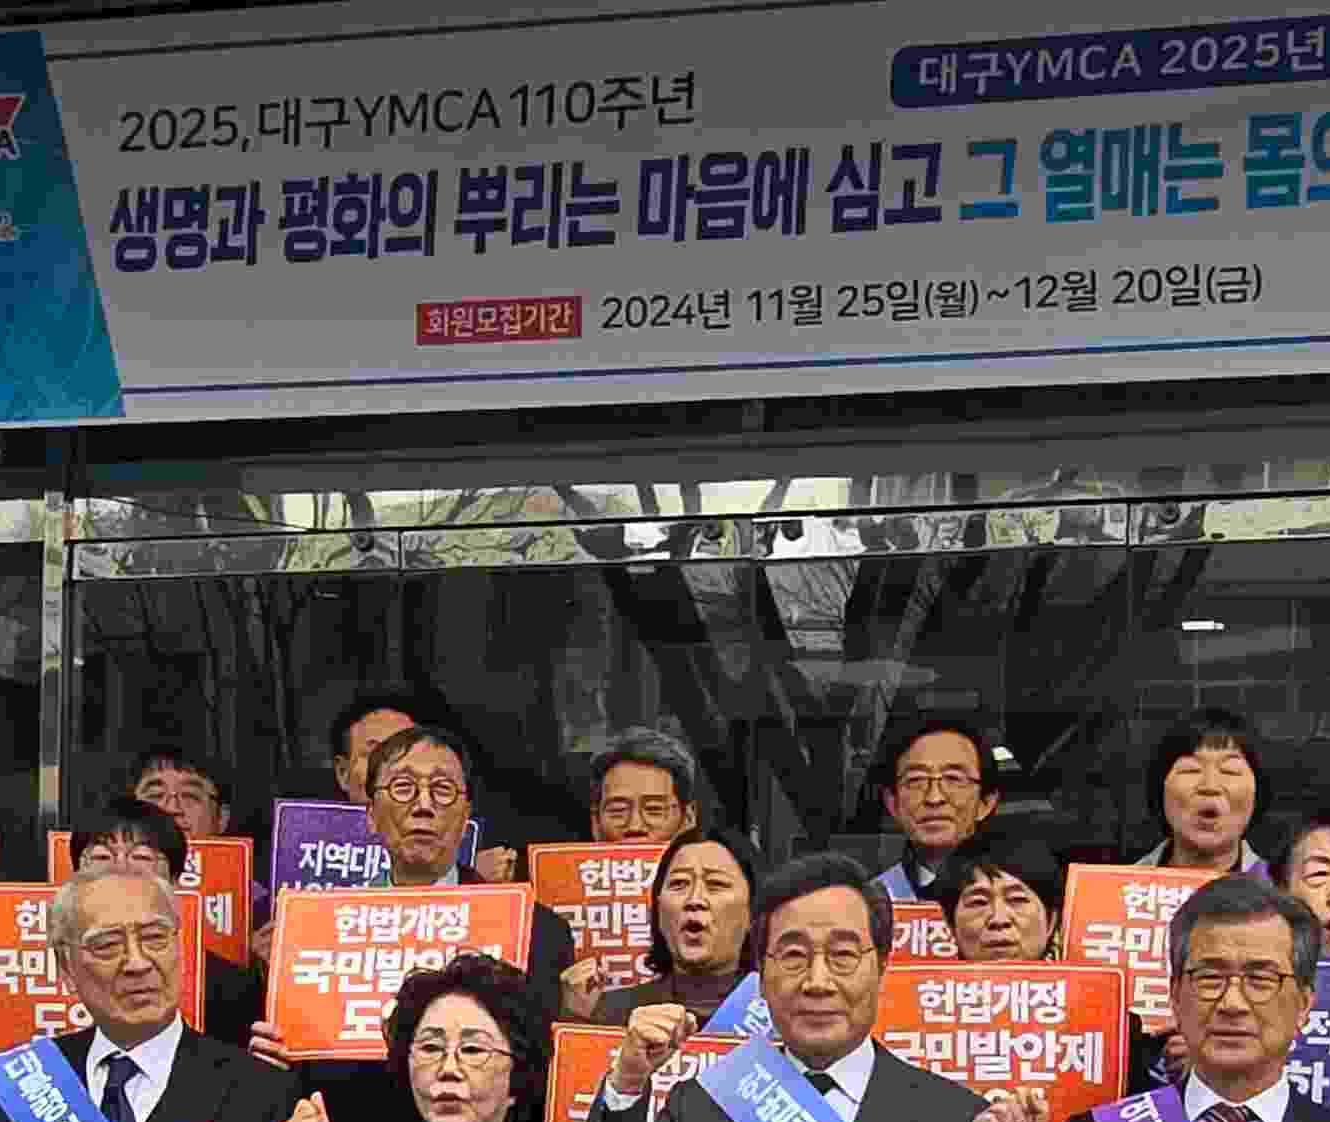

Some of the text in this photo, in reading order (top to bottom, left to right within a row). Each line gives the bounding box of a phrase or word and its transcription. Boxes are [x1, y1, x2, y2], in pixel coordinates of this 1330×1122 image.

[918, 46, 1143, 96] 대구YMCA
[1159, 24, 1327, 78] 2025년
[109, 181, 266, 273] 생명과
[278, 168, 440, 265] 평화의
[453, 158, 622, 256] 뿌리는
[637, 146, 812, 244] 마음에
[825, 139, 943, 234] 심고
[958, 139, 1019, 220] 그
[1038, 119, 1224, 226] 열매는
[599, 289, 733, 333] 2024년
[746, 283, 824, 328] 11월
[1111, 263, 1265, 310] 20일(금)
[424, 302, 575, 341] 회원모집기간
[298, 841, 390, 879] 지역대
[334, 903, 470, 944] 헌법개정
[917, 979, 1067, 1025] 헌법개정
